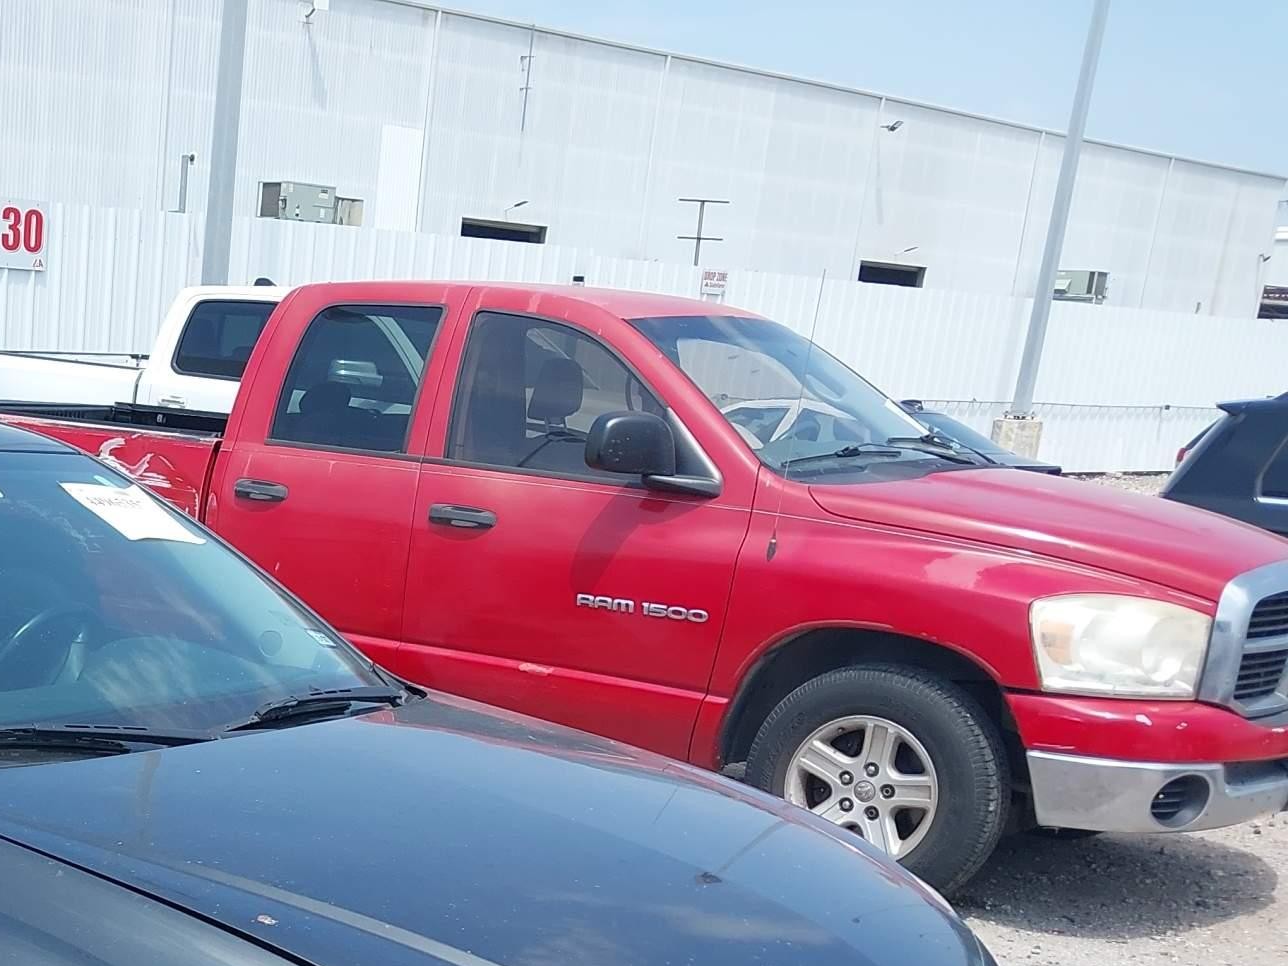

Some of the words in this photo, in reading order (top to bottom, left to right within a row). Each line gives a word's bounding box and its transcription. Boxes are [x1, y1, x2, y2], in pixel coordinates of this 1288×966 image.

[1, 206, 44, 253] 30
[576, 593, 635, 613] RAM
[641, 602, 709, 623] 1500
